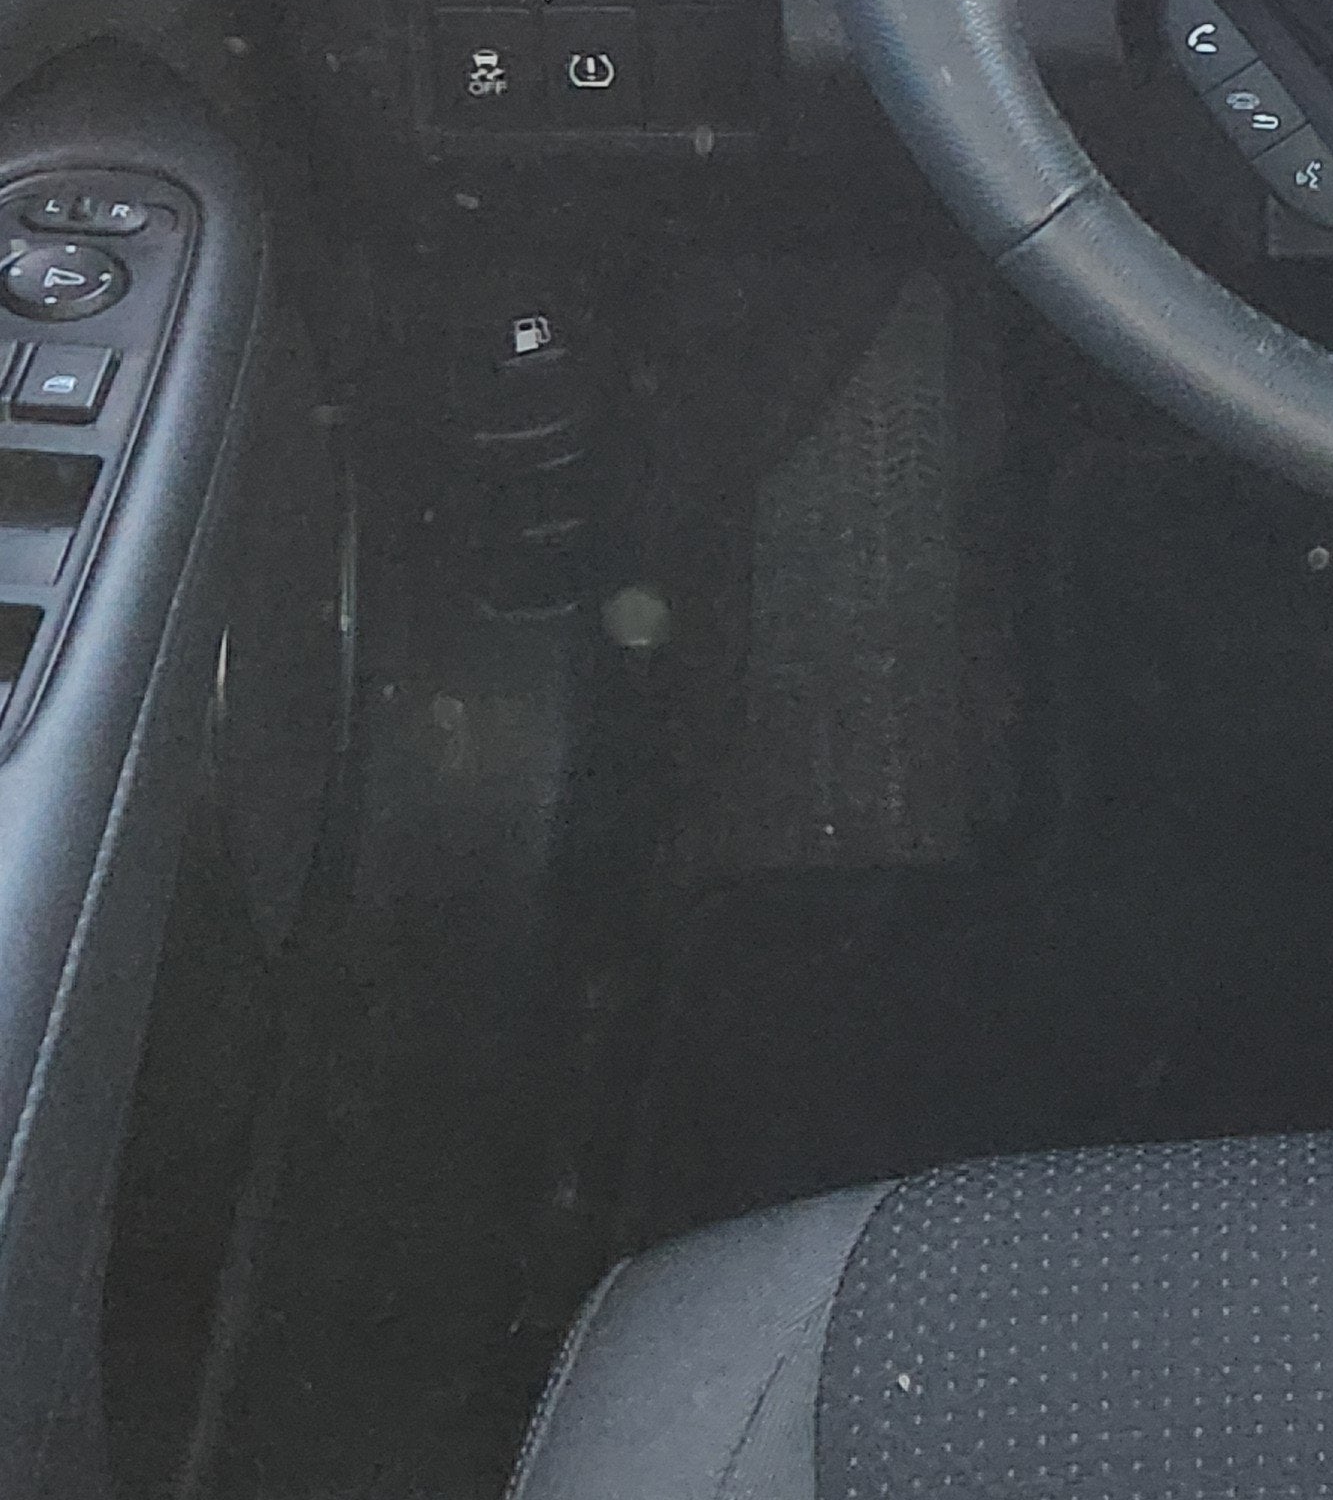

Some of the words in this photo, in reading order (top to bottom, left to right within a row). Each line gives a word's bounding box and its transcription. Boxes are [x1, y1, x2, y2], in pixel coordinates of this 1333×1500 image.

[468, 80, 508, 96] OFF
[44, 199, 60, 213] L
[110, 203, 130, 218] R
